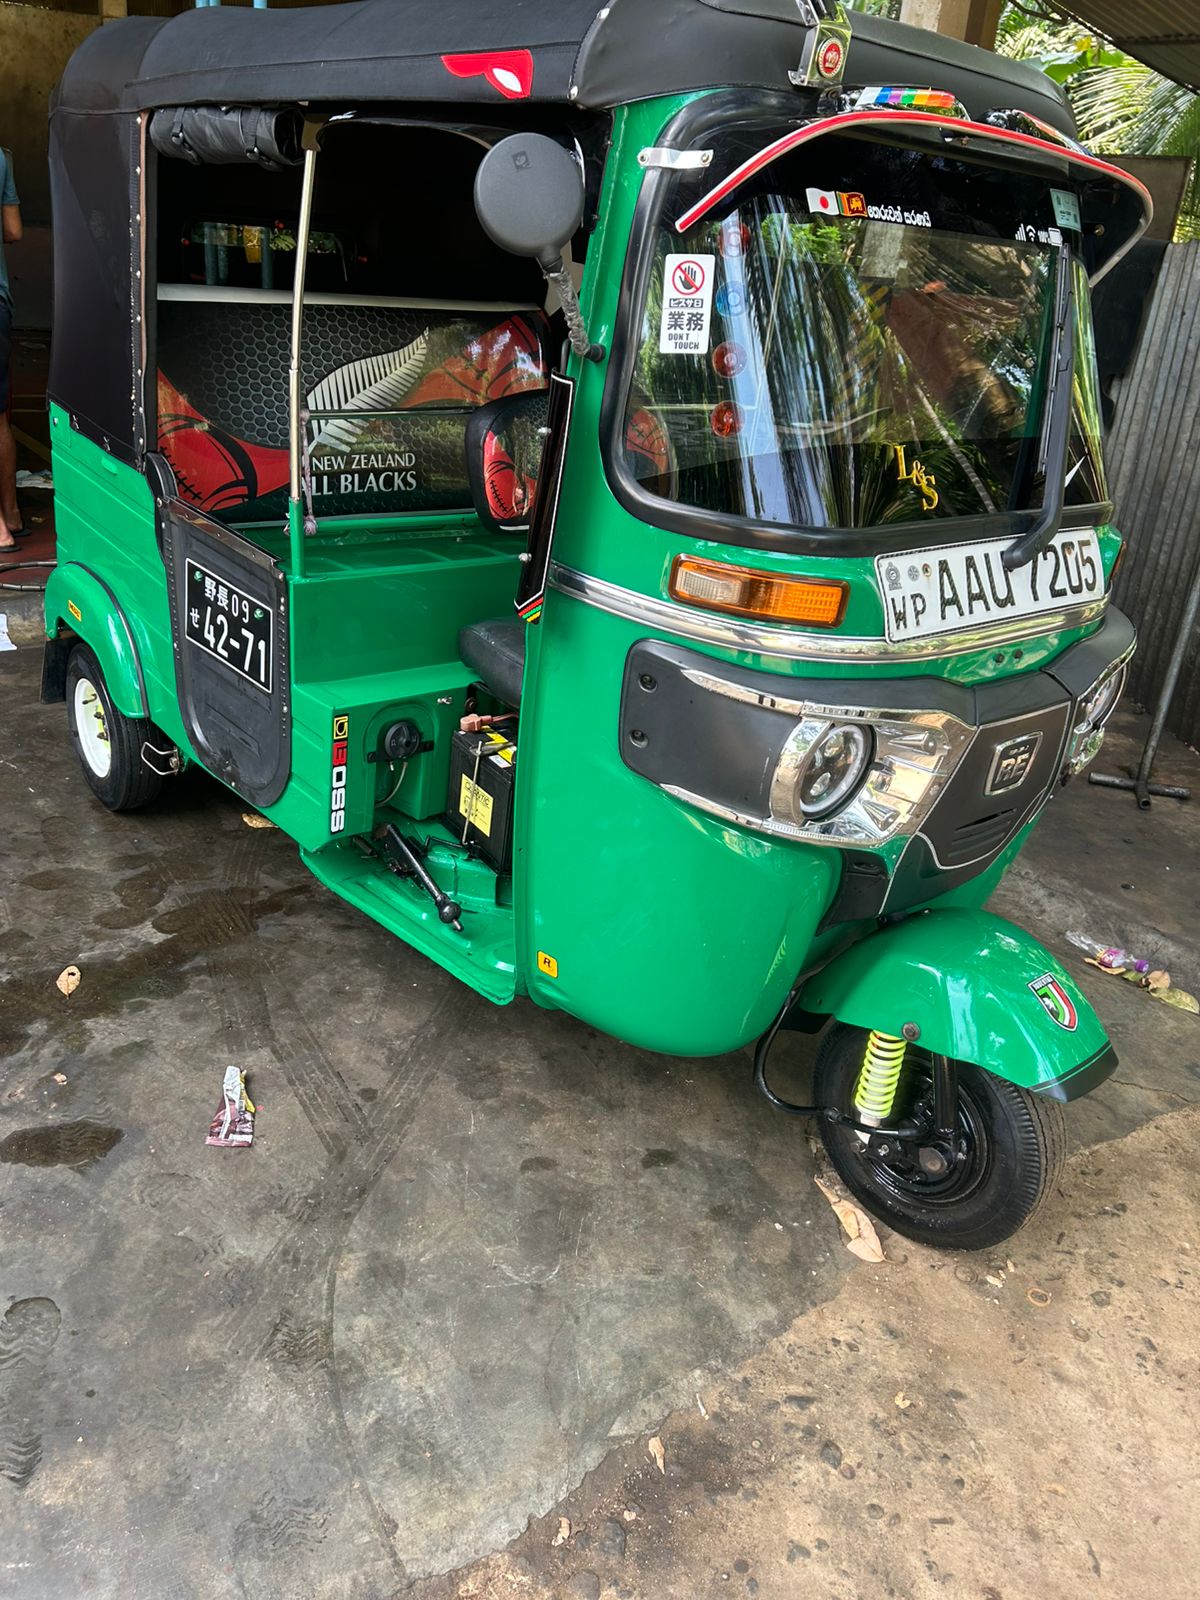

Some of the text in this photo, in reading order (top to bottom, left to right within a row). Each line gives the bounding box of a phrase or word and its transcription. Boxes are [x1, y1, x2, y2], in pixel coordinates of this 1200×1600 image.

[667, 311, 704, 331] 業務
[674, 341, 700, 350] TOUCH
[312, 452, 416, 471] NEW ZEALAND
[340, 470, 417, 494] BLACKS
[890, 592, 927, 631] WP
[937, 551, 1016, 620] AAU
[189, 606, 266, 683] せ 42-71
